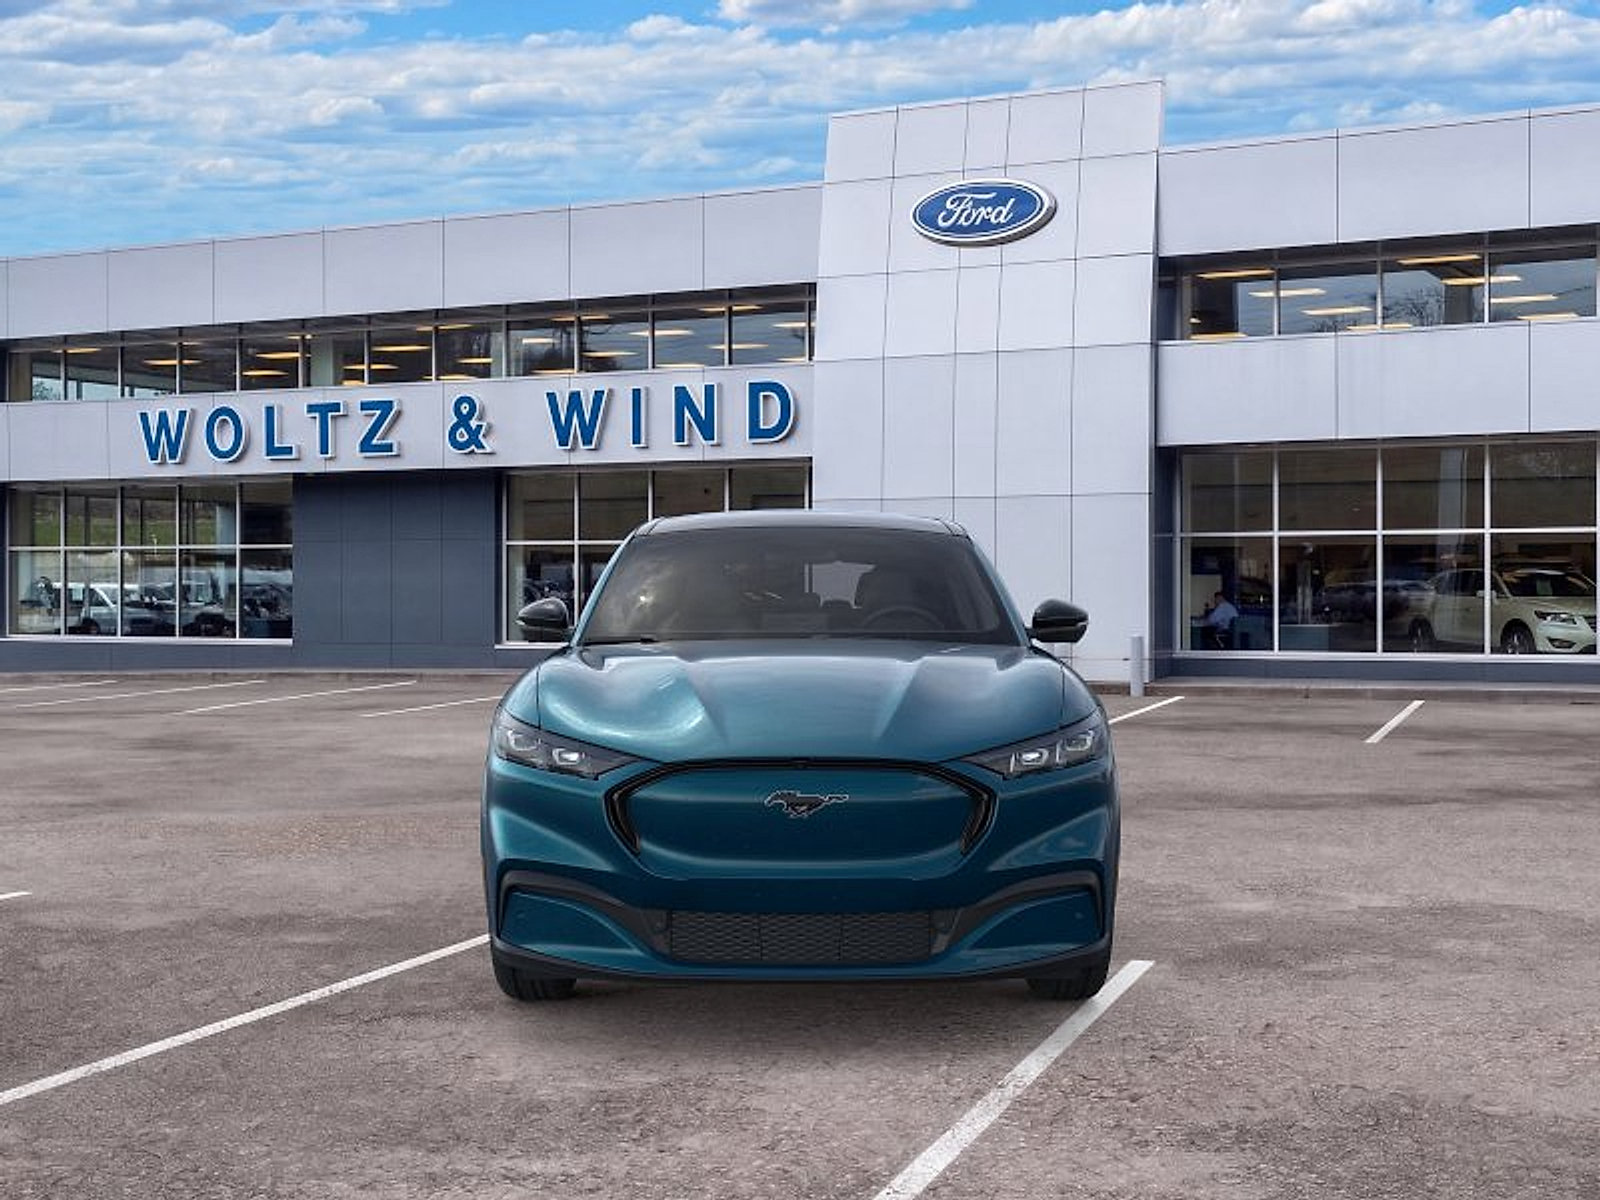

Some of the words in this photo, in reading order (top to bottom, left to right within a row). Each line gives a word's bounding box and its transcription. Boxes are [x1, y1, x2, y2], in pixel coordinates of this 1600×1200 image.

[938, 192, 1016, 228] Ford
[138, 399, 401, 465] WOLTZ
[448, 395, 493, 454] &
[546, 380, 796, 450] WIND
